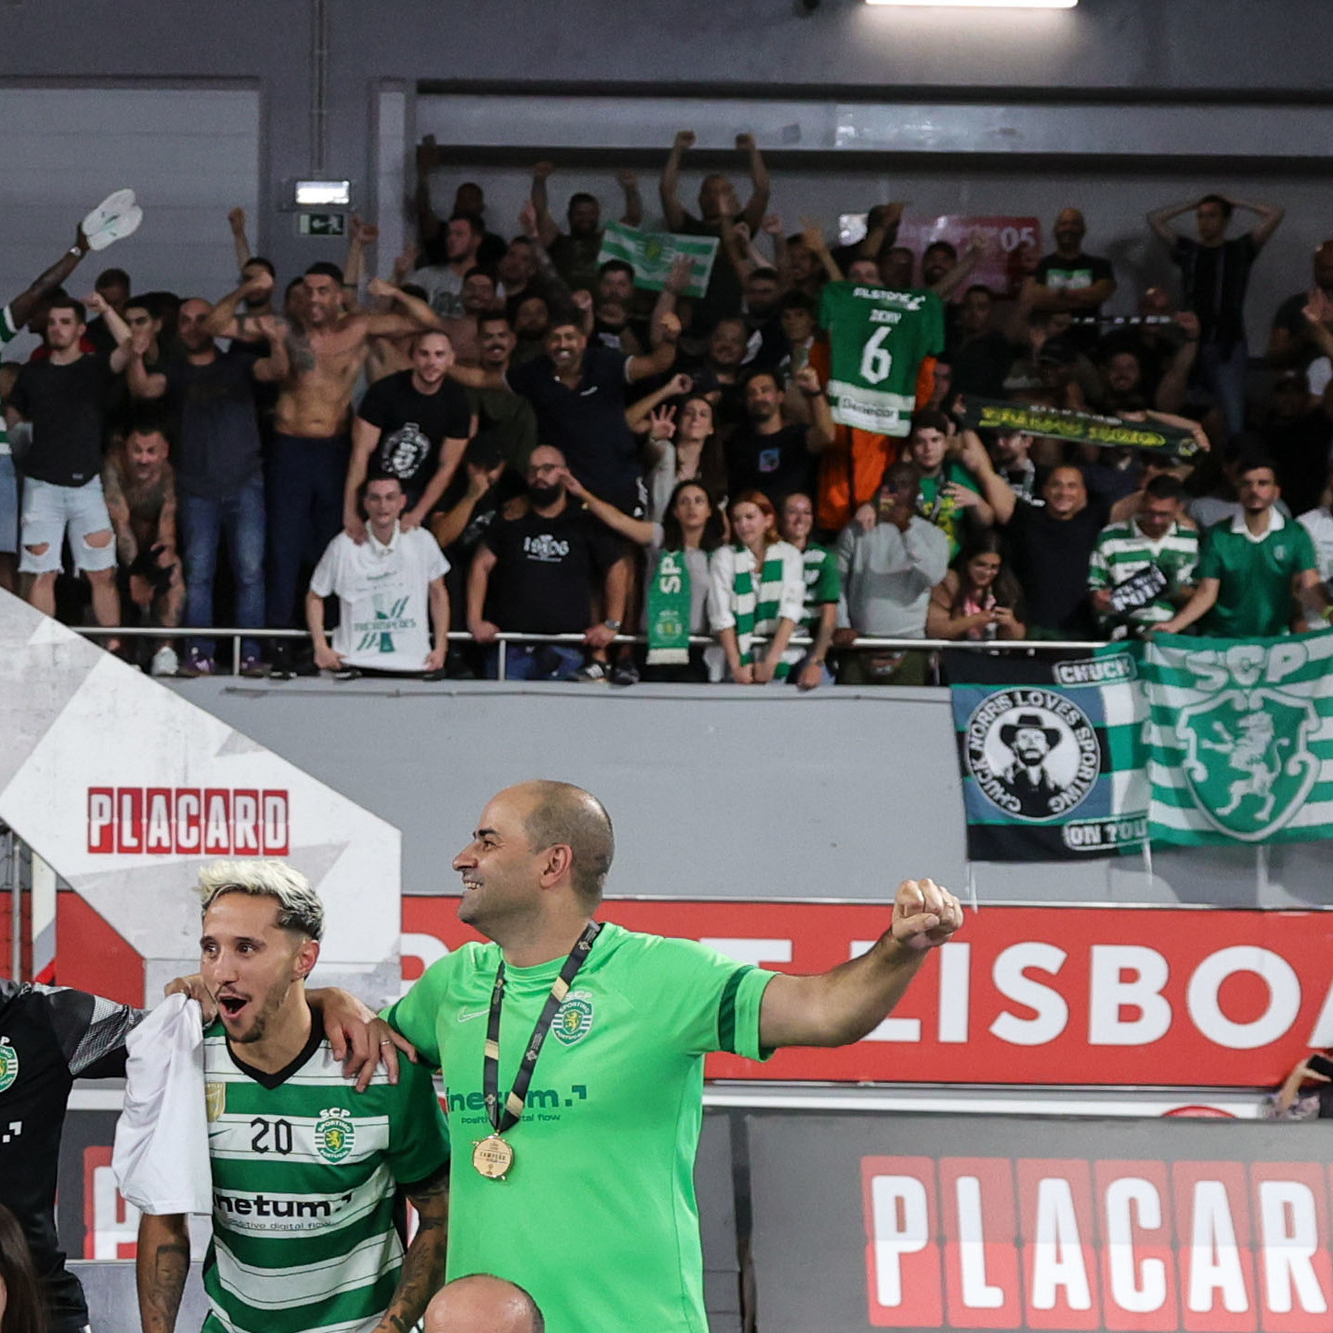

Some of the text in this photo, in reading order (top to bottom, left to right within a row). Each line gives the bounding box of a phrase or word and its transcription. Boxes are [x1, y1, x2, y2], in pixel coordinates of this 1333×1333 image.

[860, 326, 893, 385] 6
[659, 552, 682, 594] SP
[1060, 657, 1131, 685] CHUCK
[1185, 643, 1309, 691] SCP
[968, 691, 1099, 813] CHUCK NORRIS LOVES SPORTING
[89, 793, 288, 850] PLACARD
[1070, 823, 1102, 845] ON
[318, 1118, 351, 1132] SPORTING
[319, 1107, 351, 1119] SCP
[250, 1117, 293, 1156] 20
[270, 1221, 304, 1231] digital
[870, 1175, 1331, 1314] PLACAR
